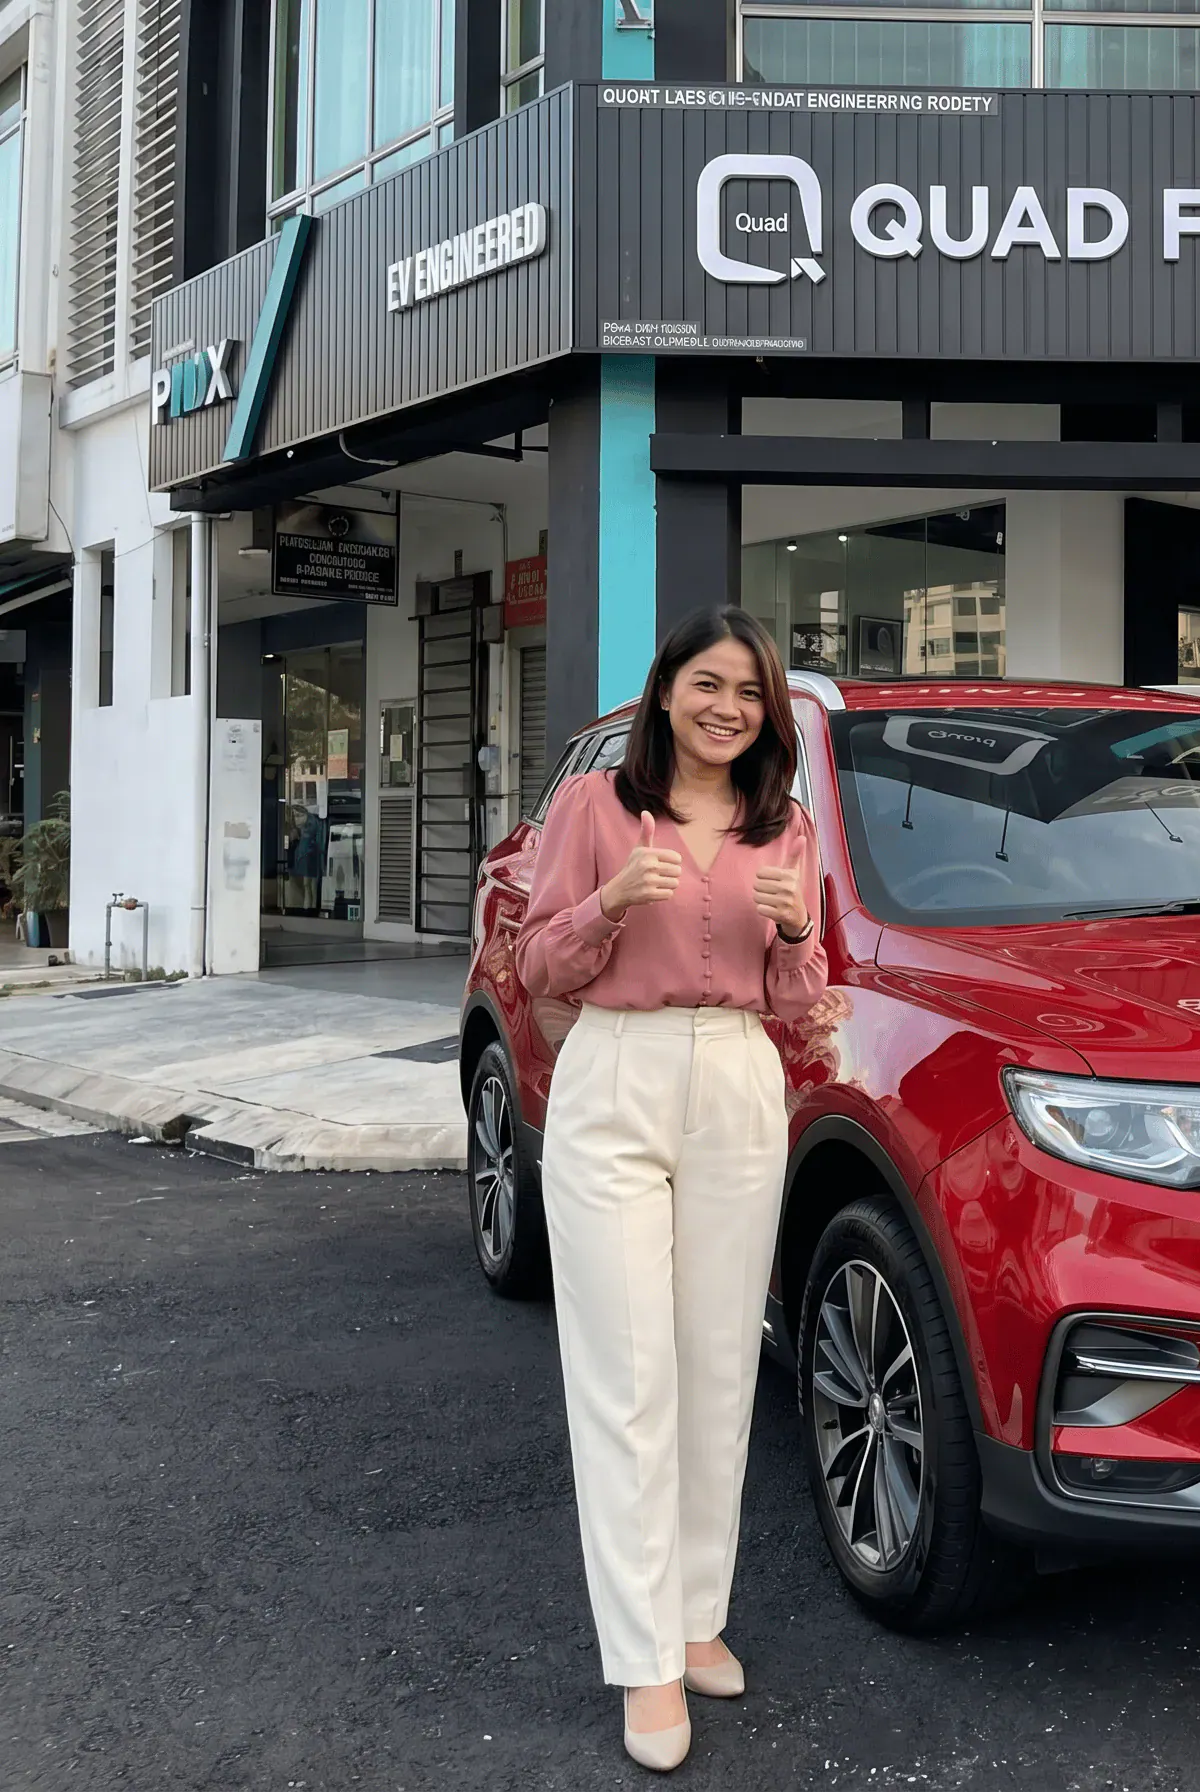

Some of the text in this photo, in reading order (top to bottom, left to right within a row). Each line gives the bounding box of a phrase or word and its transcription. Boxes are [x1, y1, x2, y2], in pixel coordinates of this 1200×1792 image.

[927, 95, 992, 112] RODETY
[735, 212, 788, 233] Quad
[850, 183, 1130, 261] QUAD
[388, 202, 546, 313] EV ENGINEERED
